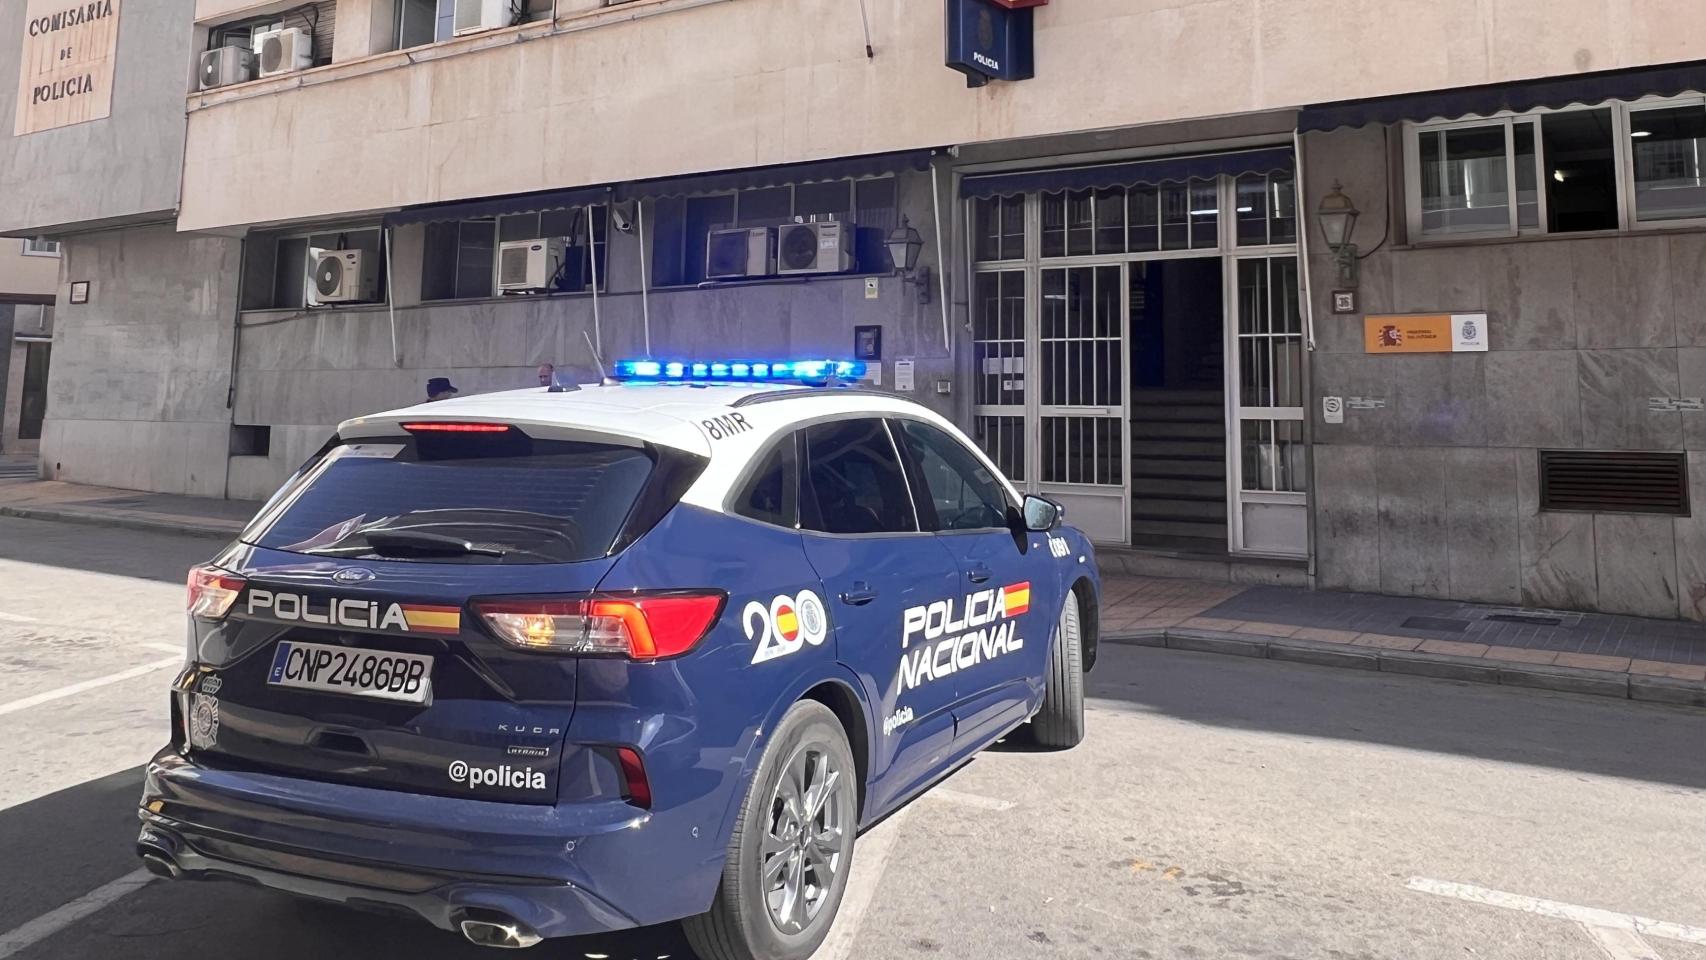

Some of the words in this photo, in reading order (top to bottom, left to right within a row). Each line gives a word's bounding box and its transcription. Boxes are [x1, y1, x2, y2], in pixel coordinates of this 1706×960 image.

[29, 0, 112, 37] COMISARIA
[60, 47, 72, 60] DE
[973, 52, 999, 70] POLICIA
[33, 73, 93, 104] POLICIA
[702, 412, 753, 440] 8MR
[742, 589, 827, 664] 200
[285, 647, 425, 694] CNP2486BB
[897, 620, 1023, 695] NACIONAL
[448, 760, 546, 789] @policia
